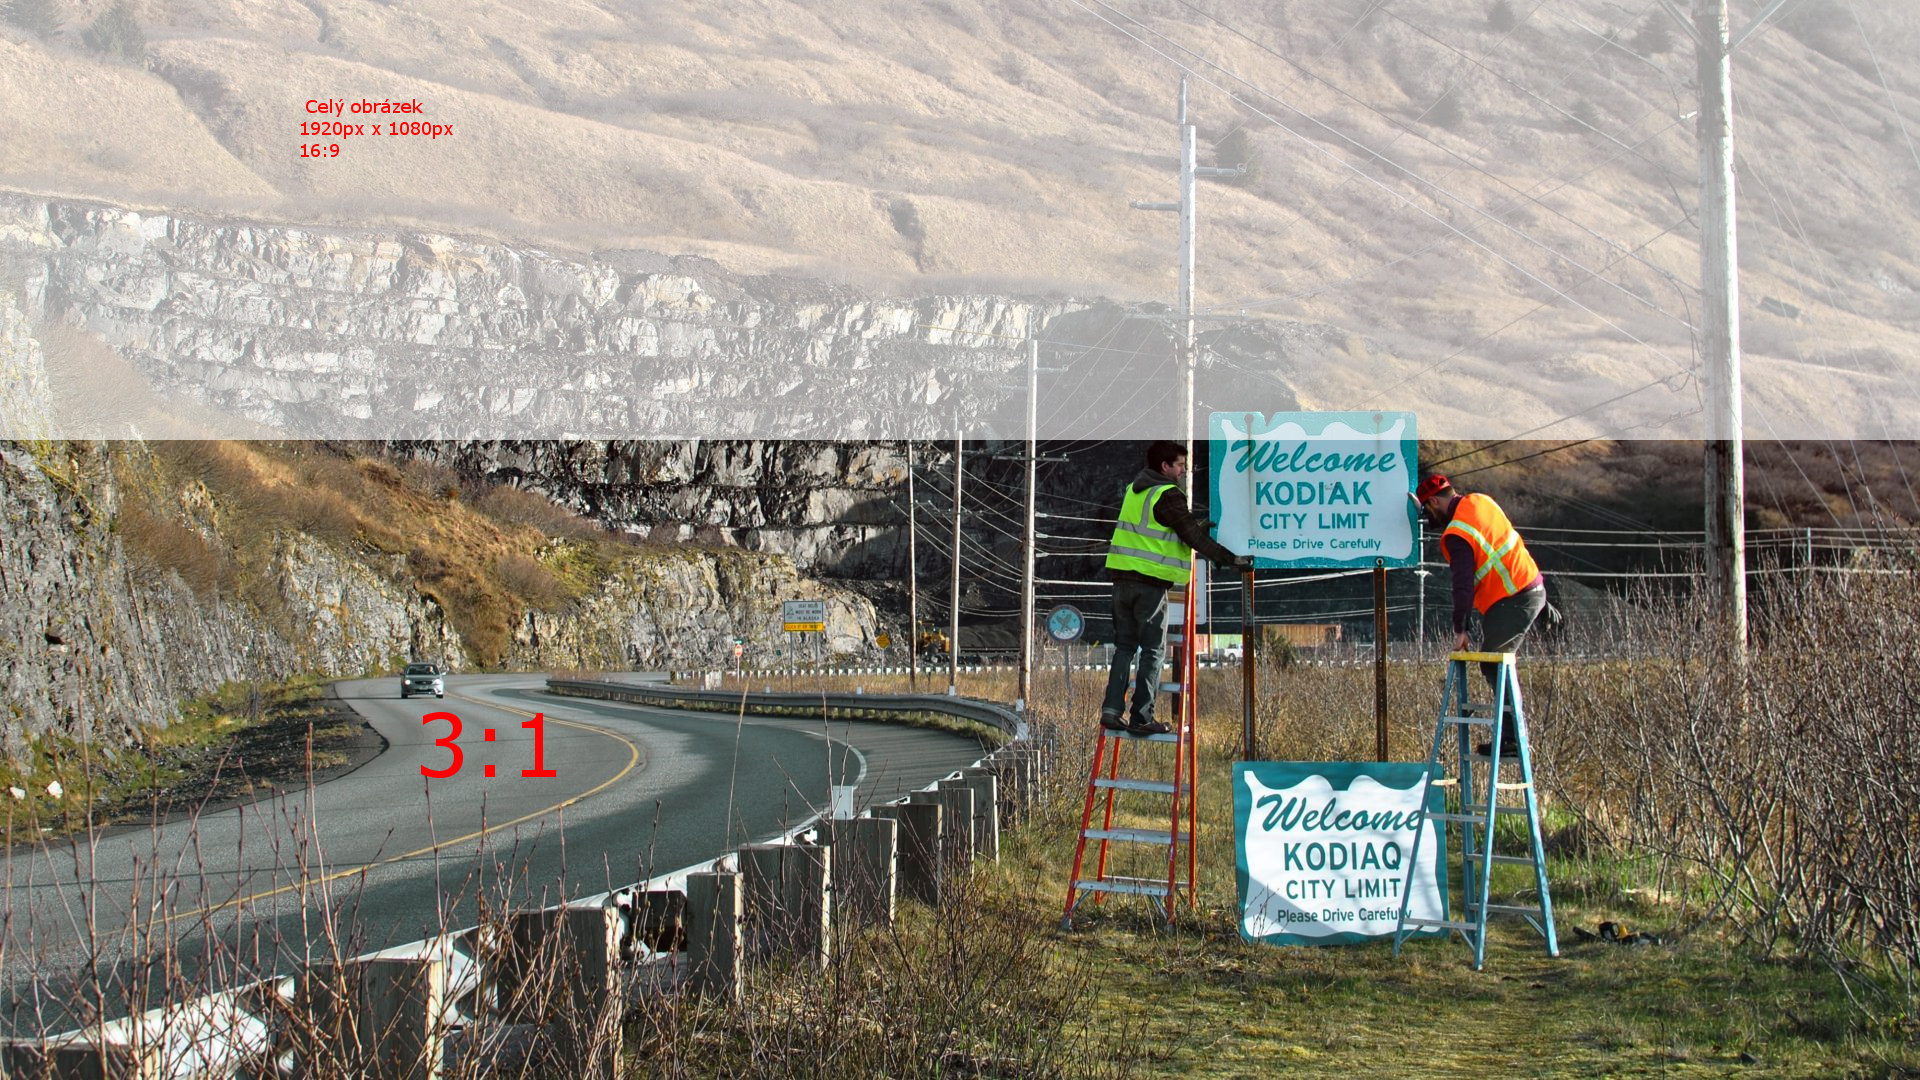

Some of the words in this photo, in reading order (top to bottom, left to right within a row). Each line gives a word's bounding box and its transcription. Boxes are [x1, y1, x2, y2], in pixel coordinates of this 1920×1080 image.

[1231, 439, 1396, 473] Welcome
[1255, 481, 1372, 506] KODIAK
[1260, 513, 1307, 530] CITY
[1318, 513, 1370, 529] LIMIT
[1248, 538, 1287, 549] Please
[1293, 539, 1324, 549] Drive
[1330, 538, 1381, 551] Carefully
[1256, 794, 1423, 832] Welcome
[1284, 841, 1401, 871] KODIAQ
[1286, 879, 1335, 900] CITY
[1345, 878, 1401, 898] LIMIT
[1277, 909, 1318, 922] Please
[1322, 908, 1354, 921] Drive
